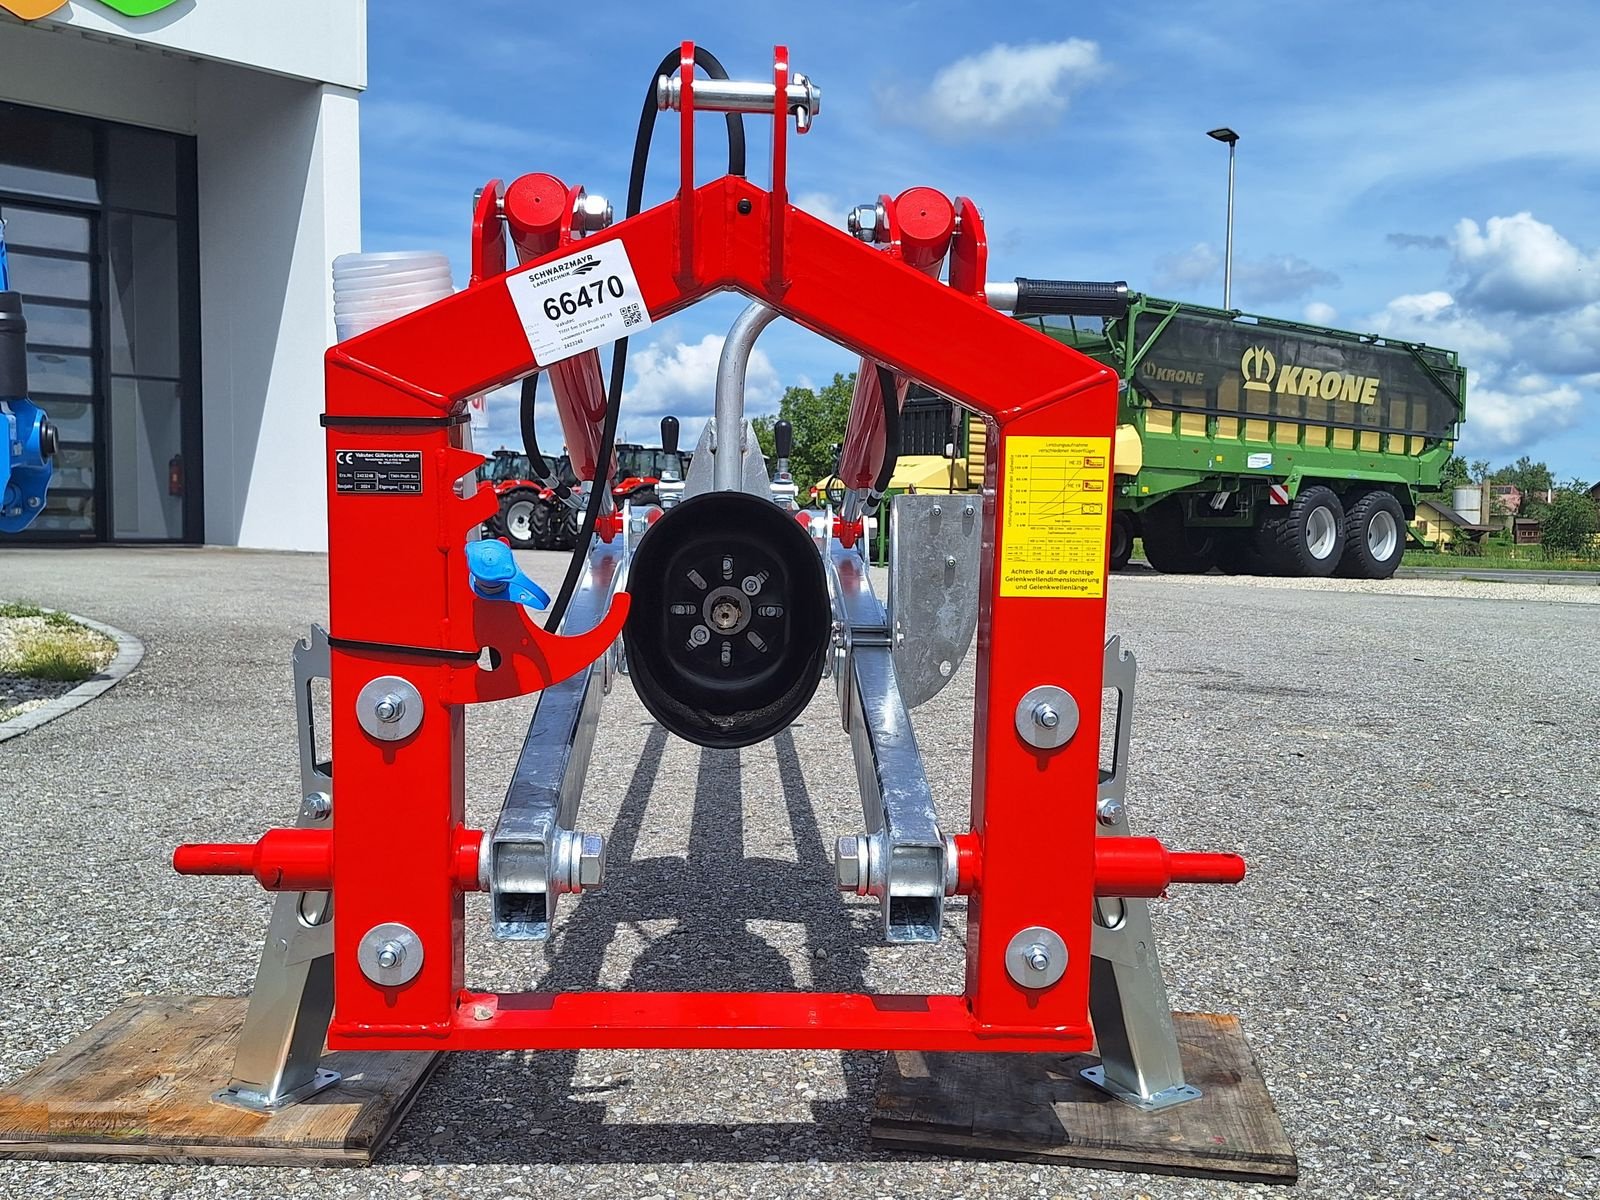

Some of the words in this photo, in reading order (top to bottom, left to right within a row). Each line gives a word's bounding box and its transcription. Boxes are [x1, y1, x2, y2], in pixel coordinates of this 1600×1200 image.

[528, 254, 594, 282] SCHWARZMAYR
[532, 272, 570, 288] LANDTECHNIK
[544, 276, 624, 320] 66470
[1156, 368, 1204, 384] KRONE
[1276, 364, 1380, 404] KRONE
